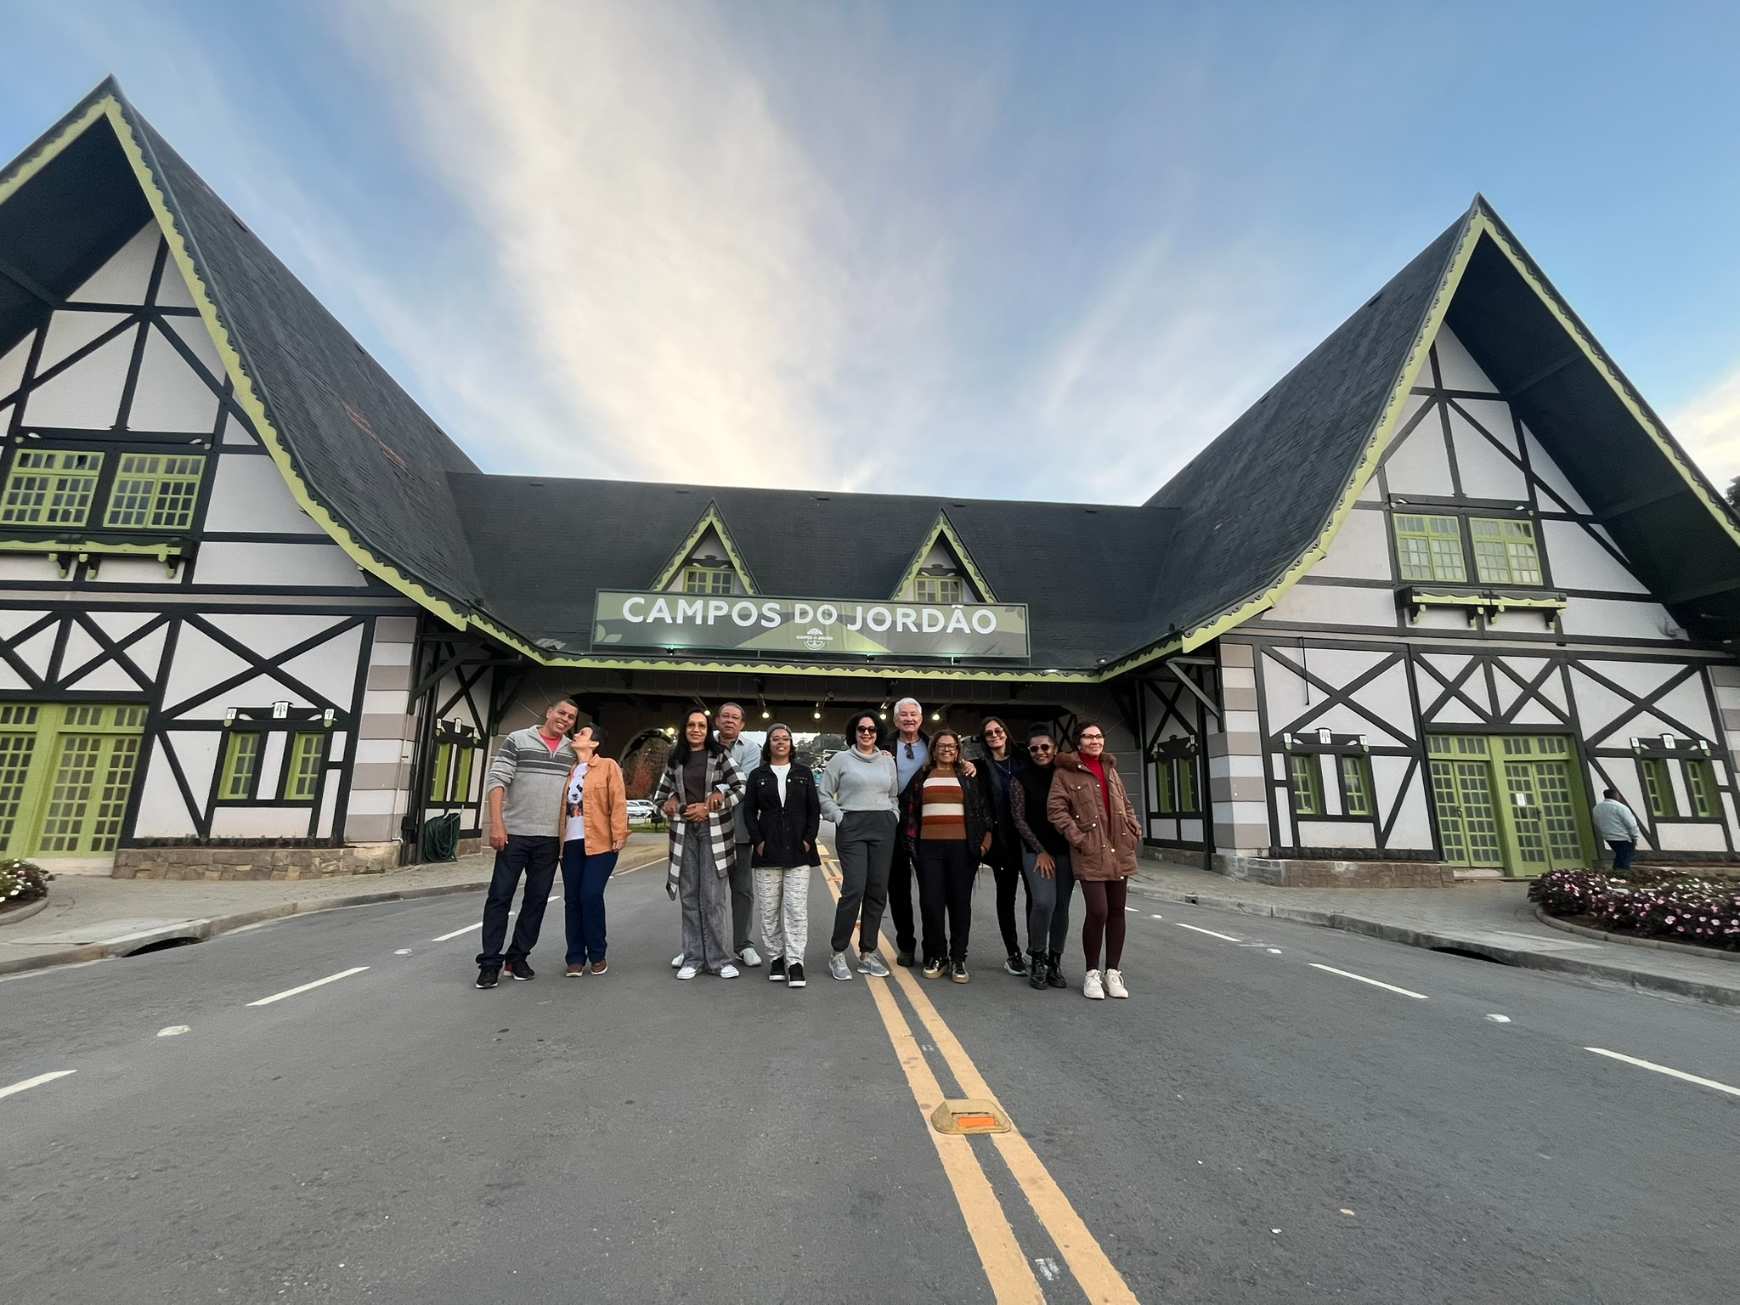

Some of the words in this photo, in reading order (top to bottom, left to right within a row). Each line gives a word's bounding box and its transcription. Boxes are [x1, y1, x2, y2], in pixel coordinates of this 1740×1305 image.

[622, 596, 782, 628] CAMPOS
[793, 603, 838, 627] DO
[846, 604, 998, 635] JORDÃO
